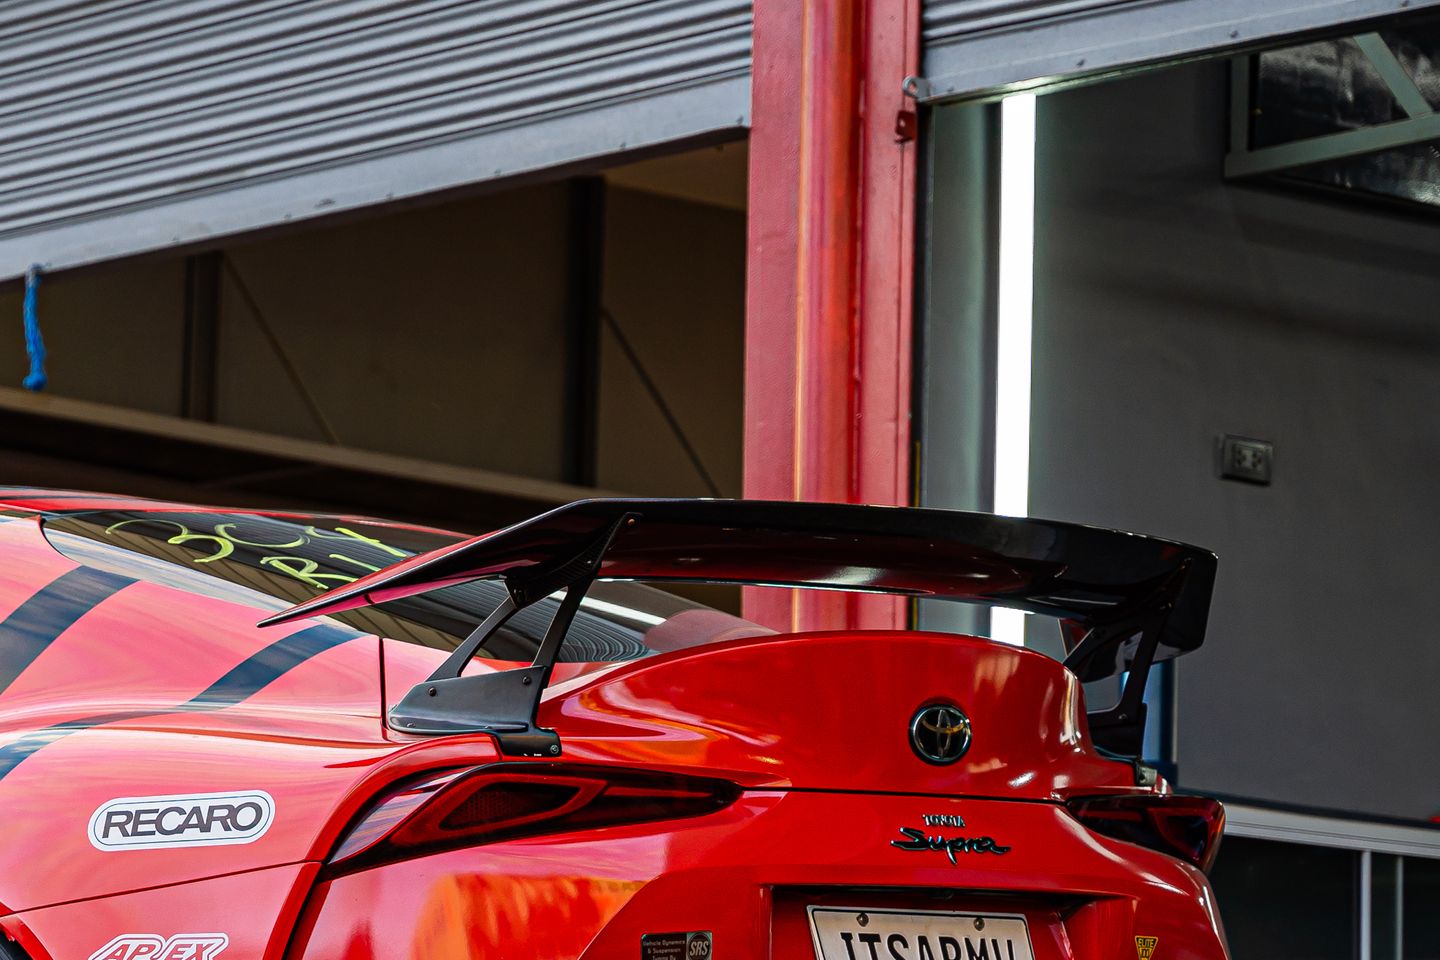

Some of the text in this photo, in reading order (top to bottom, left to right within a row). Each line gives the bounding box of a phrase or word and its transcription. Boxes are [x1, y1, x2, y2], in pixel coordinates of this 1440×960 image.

[101, 801, 264, 840] RECARO
[922, 814, 966, 827] TOYOTA
[890, 827, 1011, 865] Supra
[689, 940, 709, 957] SRS
